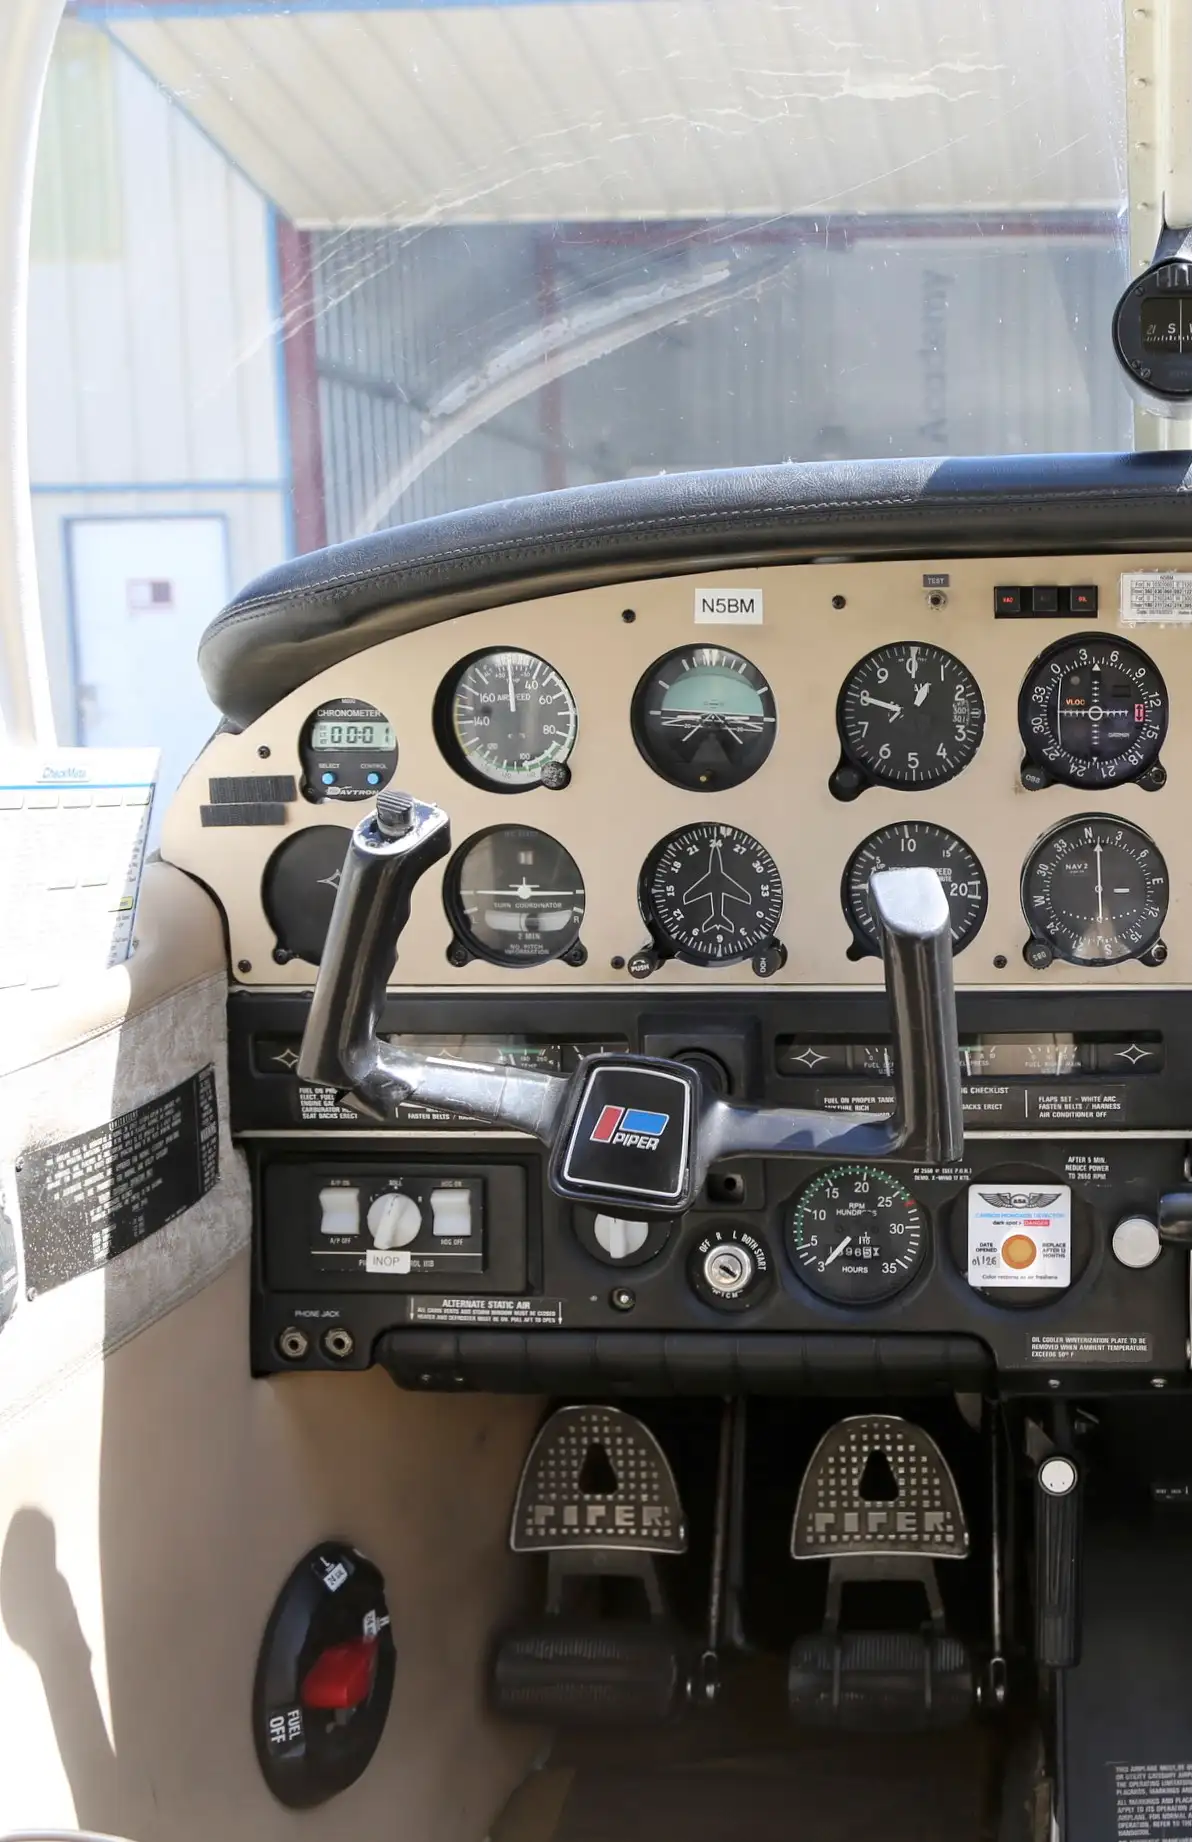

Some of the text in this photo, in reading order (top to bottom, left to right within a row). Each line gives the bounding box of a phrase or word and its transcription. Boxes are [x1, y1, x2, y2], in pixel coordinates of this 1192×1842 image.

[1167, 323, 1176, 334] S
[702, 598, 755, 613] N5BM
[1078, 648, 1088, 661] 3
[1110, 650, 1119, 662] 6
[1050, 663, 1061, 674] 0
[1134, 667, 1146, 678] 9
[876, 667, 889, 684] 9
[525, 681, 538, 690] 40
[480, 693, 496, 703] 160
[954, 684, 965, 701] 2
[1031, 686, 1046, 702] 33
[539, 695, 553, 705] 60
[1065, 698, 1086, 706] VLOC
[1148, 691, 1162, 707] 12
[317, 709, 381, 717] CHRONOMETER
[474, 716, 490, 726] 140
[1031, 716, 1045, 734] 30
[542, 725, 556, 735] 80
[857, 721, 869, 738] 7
[954, 724, 966, 742] 3
[1146, 724, 1160, 740] 15
[879, 743, 891, 759] 6
[936, 742, 947, 759] 4
[1042, 747, 1060, 761] 27
[907, 752, 919, 769] 5
[1128, 750, 1144, 766] 18
[1069, 764, 1087, 777] 24
[1101, 765, 1116, 779] 21
[1084, 827, 1093, 839] N
[1115, 831, 1123, 841] 3
[686, 844, 700, 856] 21
[732, 844, 746, 855] 27
[901, 838, 917, 852] 10
[1053, 839, 1067, 852] 33
[942, 850, 951, 858] 15
[1139, 849, 1149, 858] 6
[670, 861, 682, 874] 18
[752, 860, 764, 873] 30
[1036, 863, 1049, 877] 30
[1152, 877, 1164, 885] E
[666, 885, 675, 897] 15
[760, 884, 769, 897] 33
[950, 882, 968, 897] 20
[1033, 895, 1045, 907] W
[672, 908, 684, 921] 12
[756, 910, 765, 918] 0
[1148, 906, 1160, 918] 12
[739, 927, 748, 936] 3
[1046, 923, 1059, 934] 24
[1130, 931, 1143, 943] 15
[630, 963, 650, 972] PUSH
[612, 1132, 660, 1151] PIPER
[854, 1181, 870, 1193] 20
[825, 1188, 840, 1199] 15
[848, 1202, 866, 1210] RPM
[877, 1196, 893, 1208] 25
[812, 1209, 827, 1220] 10
[889, 1223, 905, 1235] 30
[698, 1240, 712, 1253] OFF
[741, 1233, 759, 1251] BOTH
[810, 1235, 818, 1246] 5
[372, 1255, 400, 1267] INOP
[754, 1248, 767, 1271] START
[881, 1262, 897, 1274] 35
[442, 1299, 531, 1310] ALTERNATE STATIC AIR
[295, 1310, 340, 1318] PHONE JACK
[534, 1504, 663, 1526] PIPER
[815, 1512, 945, 1532] PIPER
[269, 1716, 288, 1744] OFF
[287, 1709, 302, 1741] FUEL
